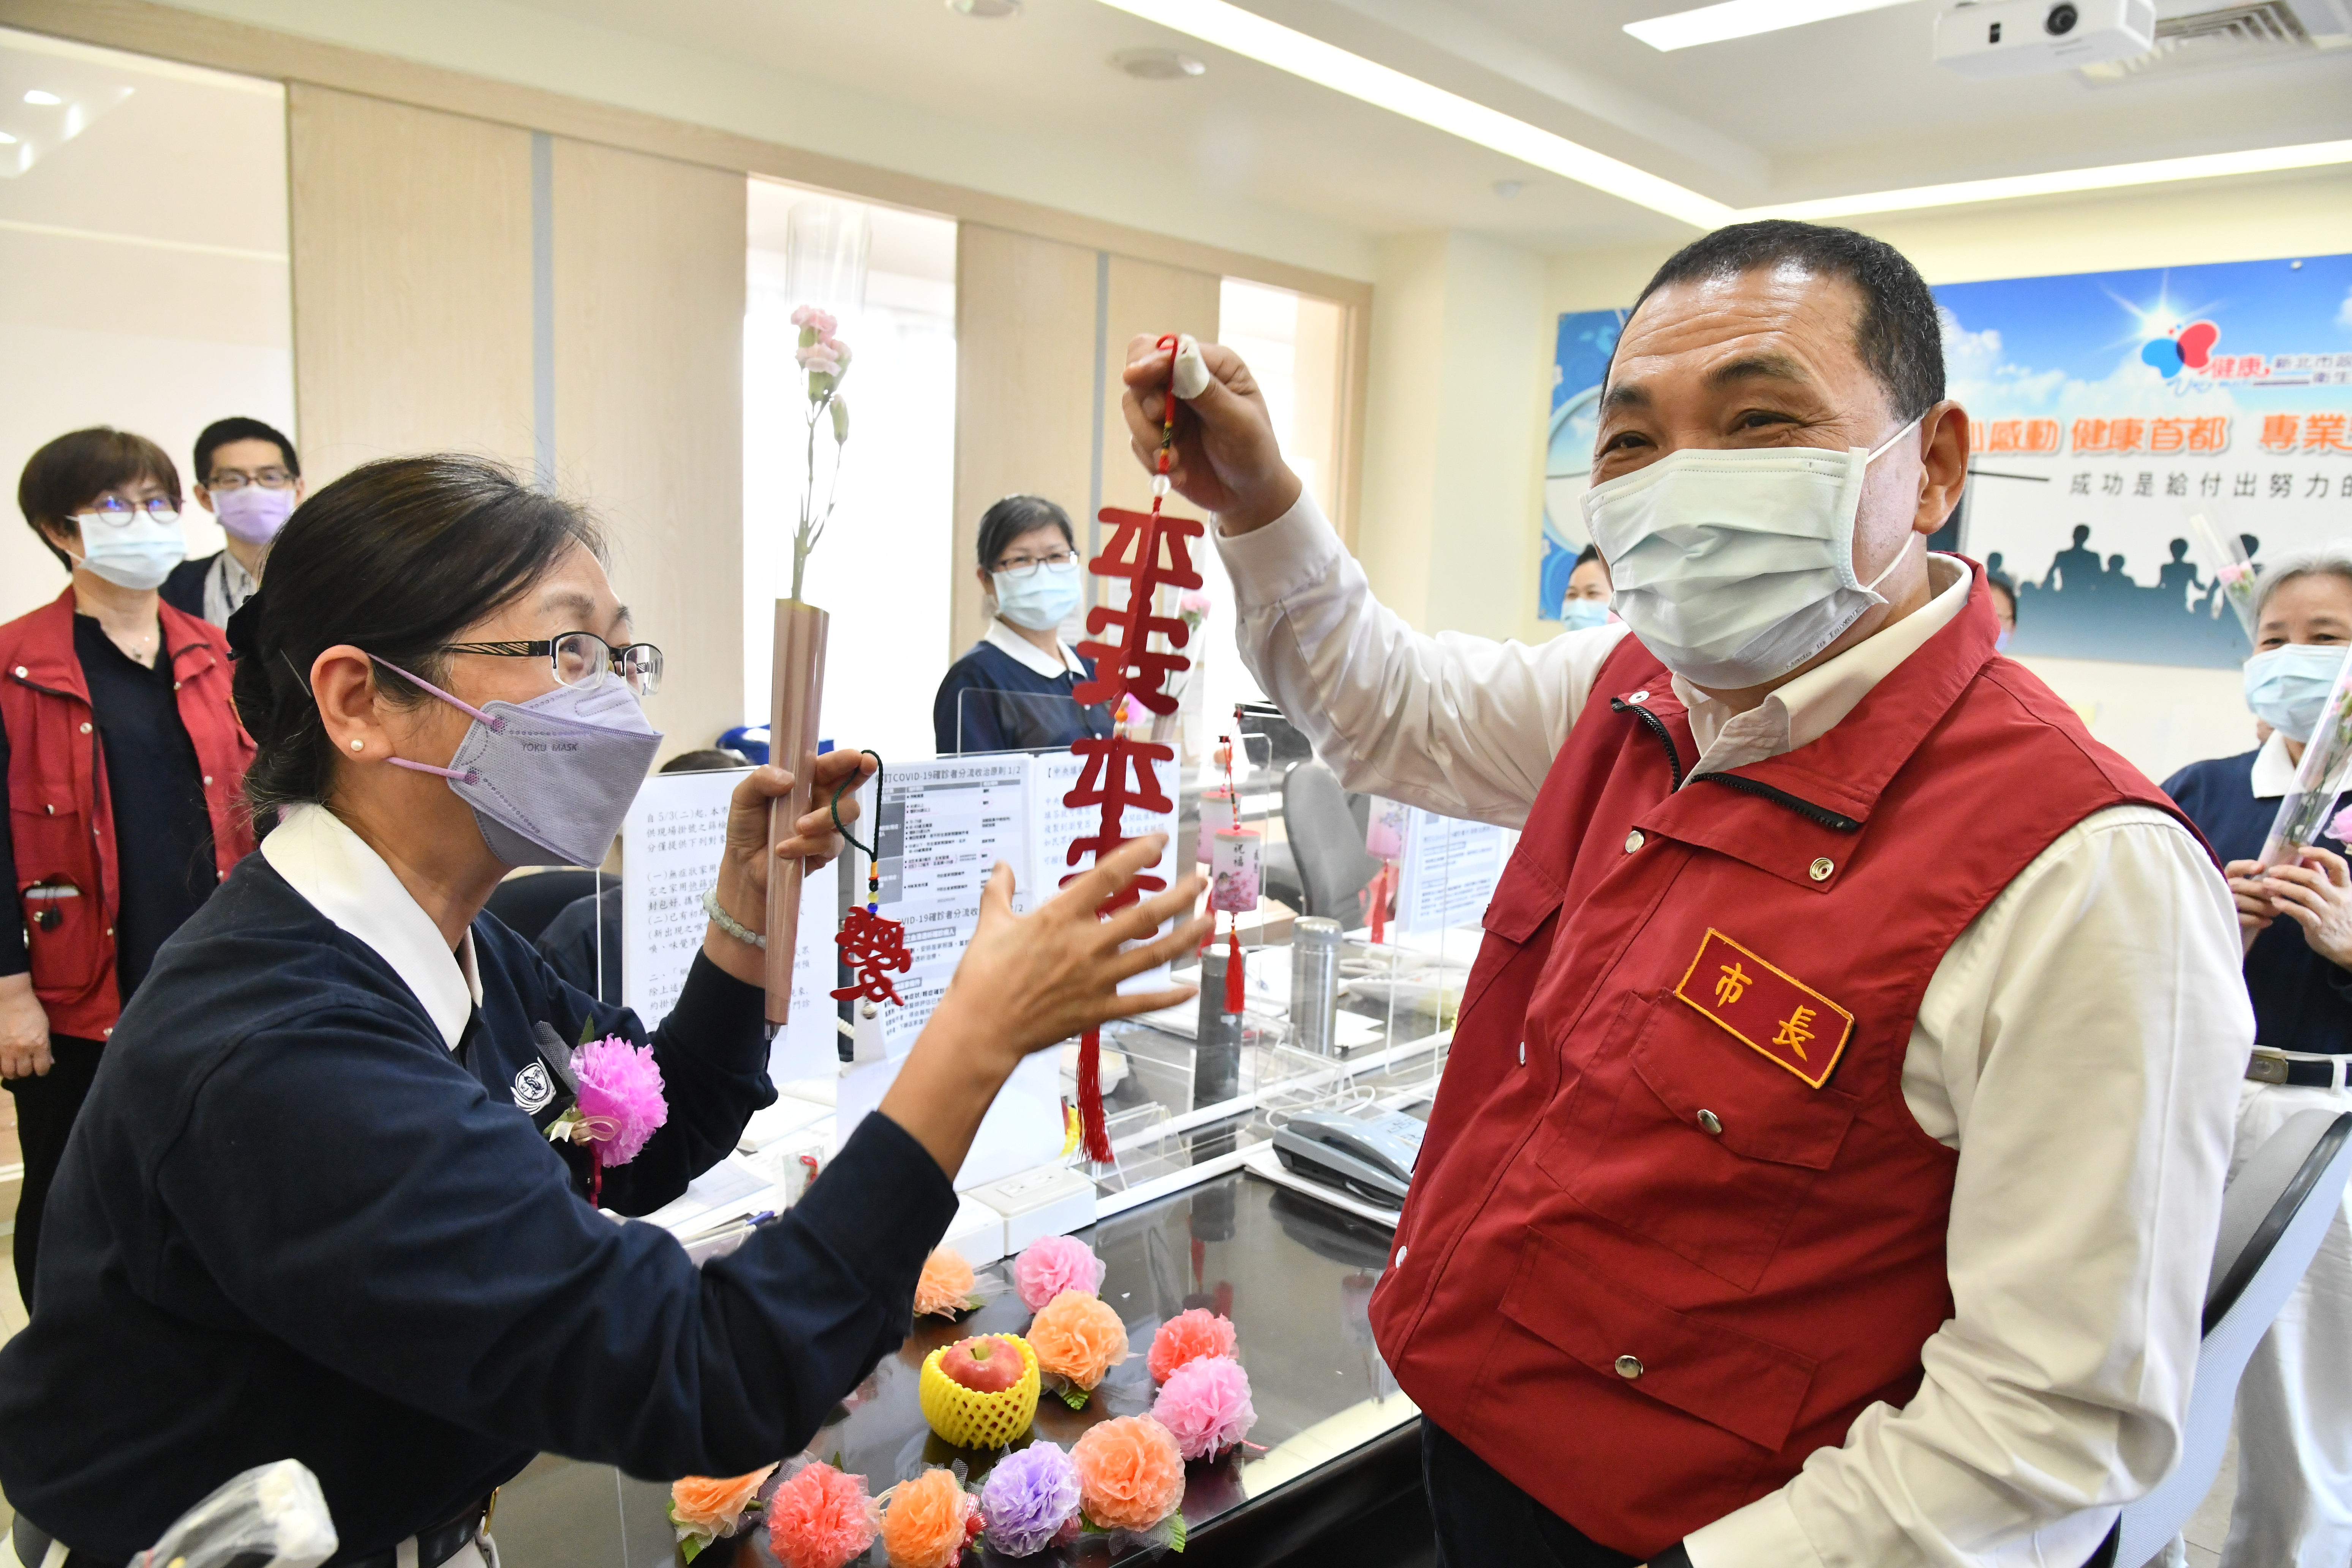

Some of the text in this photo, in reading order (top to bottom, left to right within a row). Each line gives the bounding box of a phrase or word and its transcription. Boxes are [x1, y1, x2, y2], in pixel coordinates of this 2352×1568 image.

[2072, 416, 2228, 451] 健康首都
[552, 743, 578, 751] MASK
[1008, 766, 1021, 775] 1/2
[1715, 963, 1817, 1061] 市長
